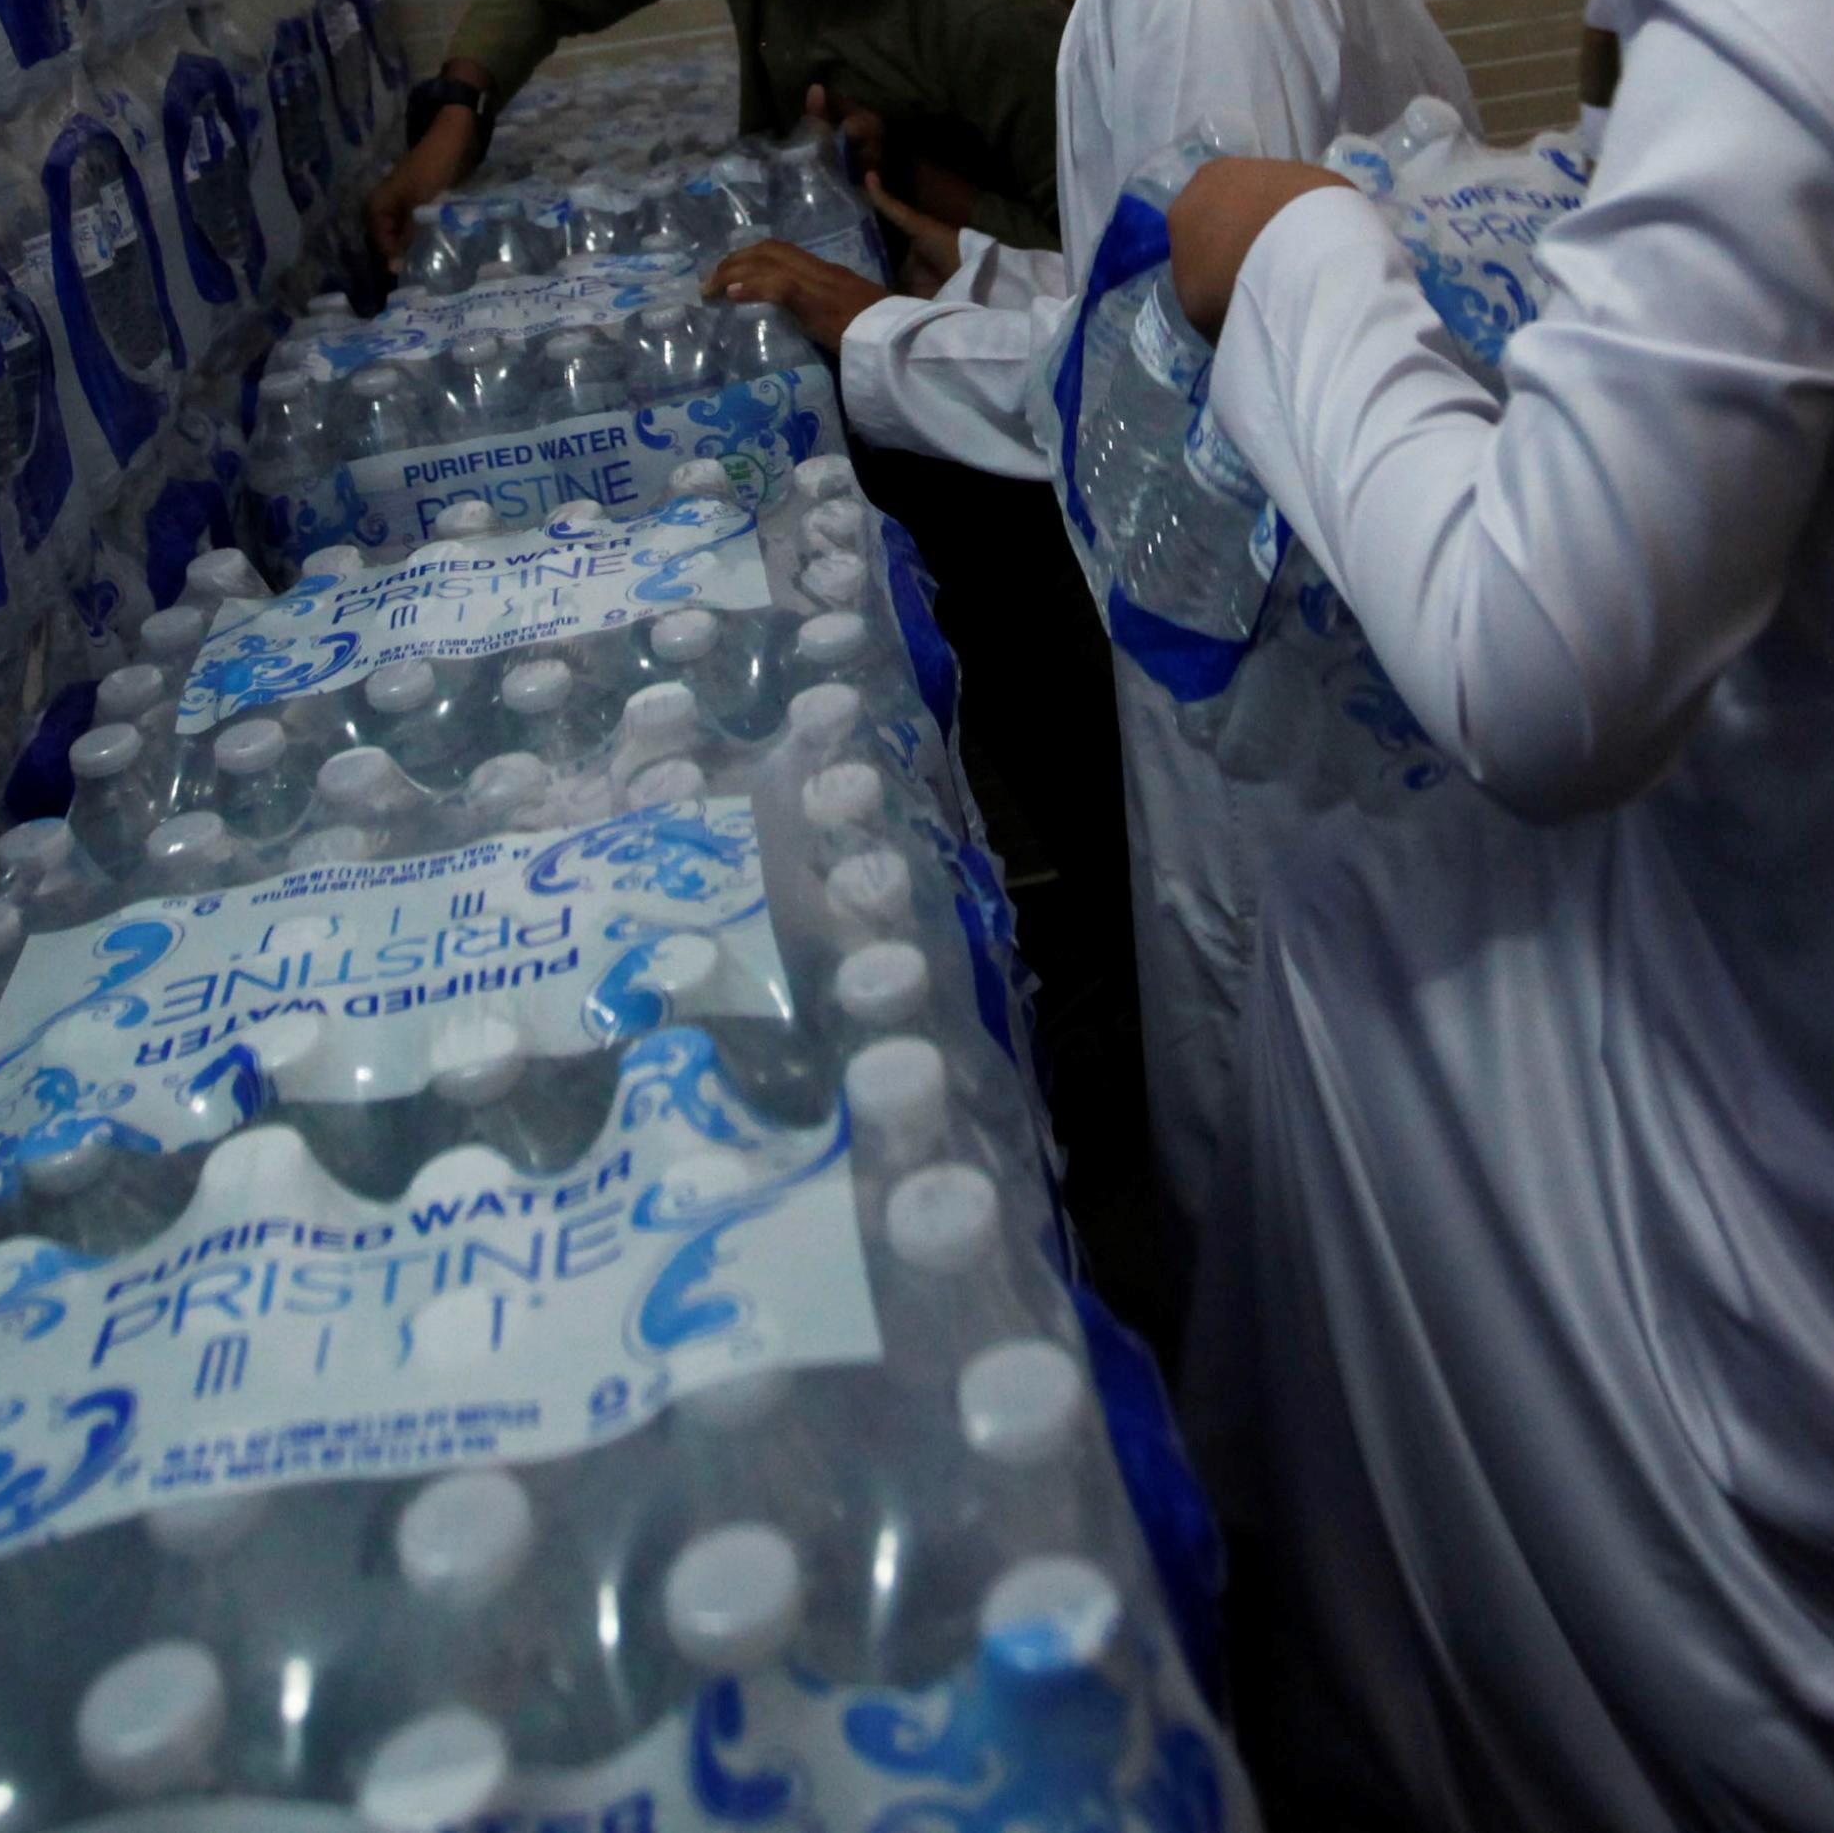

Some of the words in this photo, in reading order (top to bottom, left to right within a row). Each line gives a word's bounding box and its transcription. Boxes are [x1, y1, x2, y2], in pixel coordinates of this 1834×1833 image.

[404, 444, 535, 489] PURIFIED
[538, 424, 628, 462] WATER
[331, 552, 626, 625] PRISTINE
[334, 558, 496, 603] PURIFIED
[505, 536, 633, 567] WATER
[152, 906, 573, 1027] PRISTINE
[343, 946, 580, 1019] PURIFIED
[133, 994, 327, 1068] WATER
[103, 1217, 394, 1304] PURIFIED
[408, 1149, 632, 1237] WATER
[90, 1198, 626, 1369] PRISTINE
